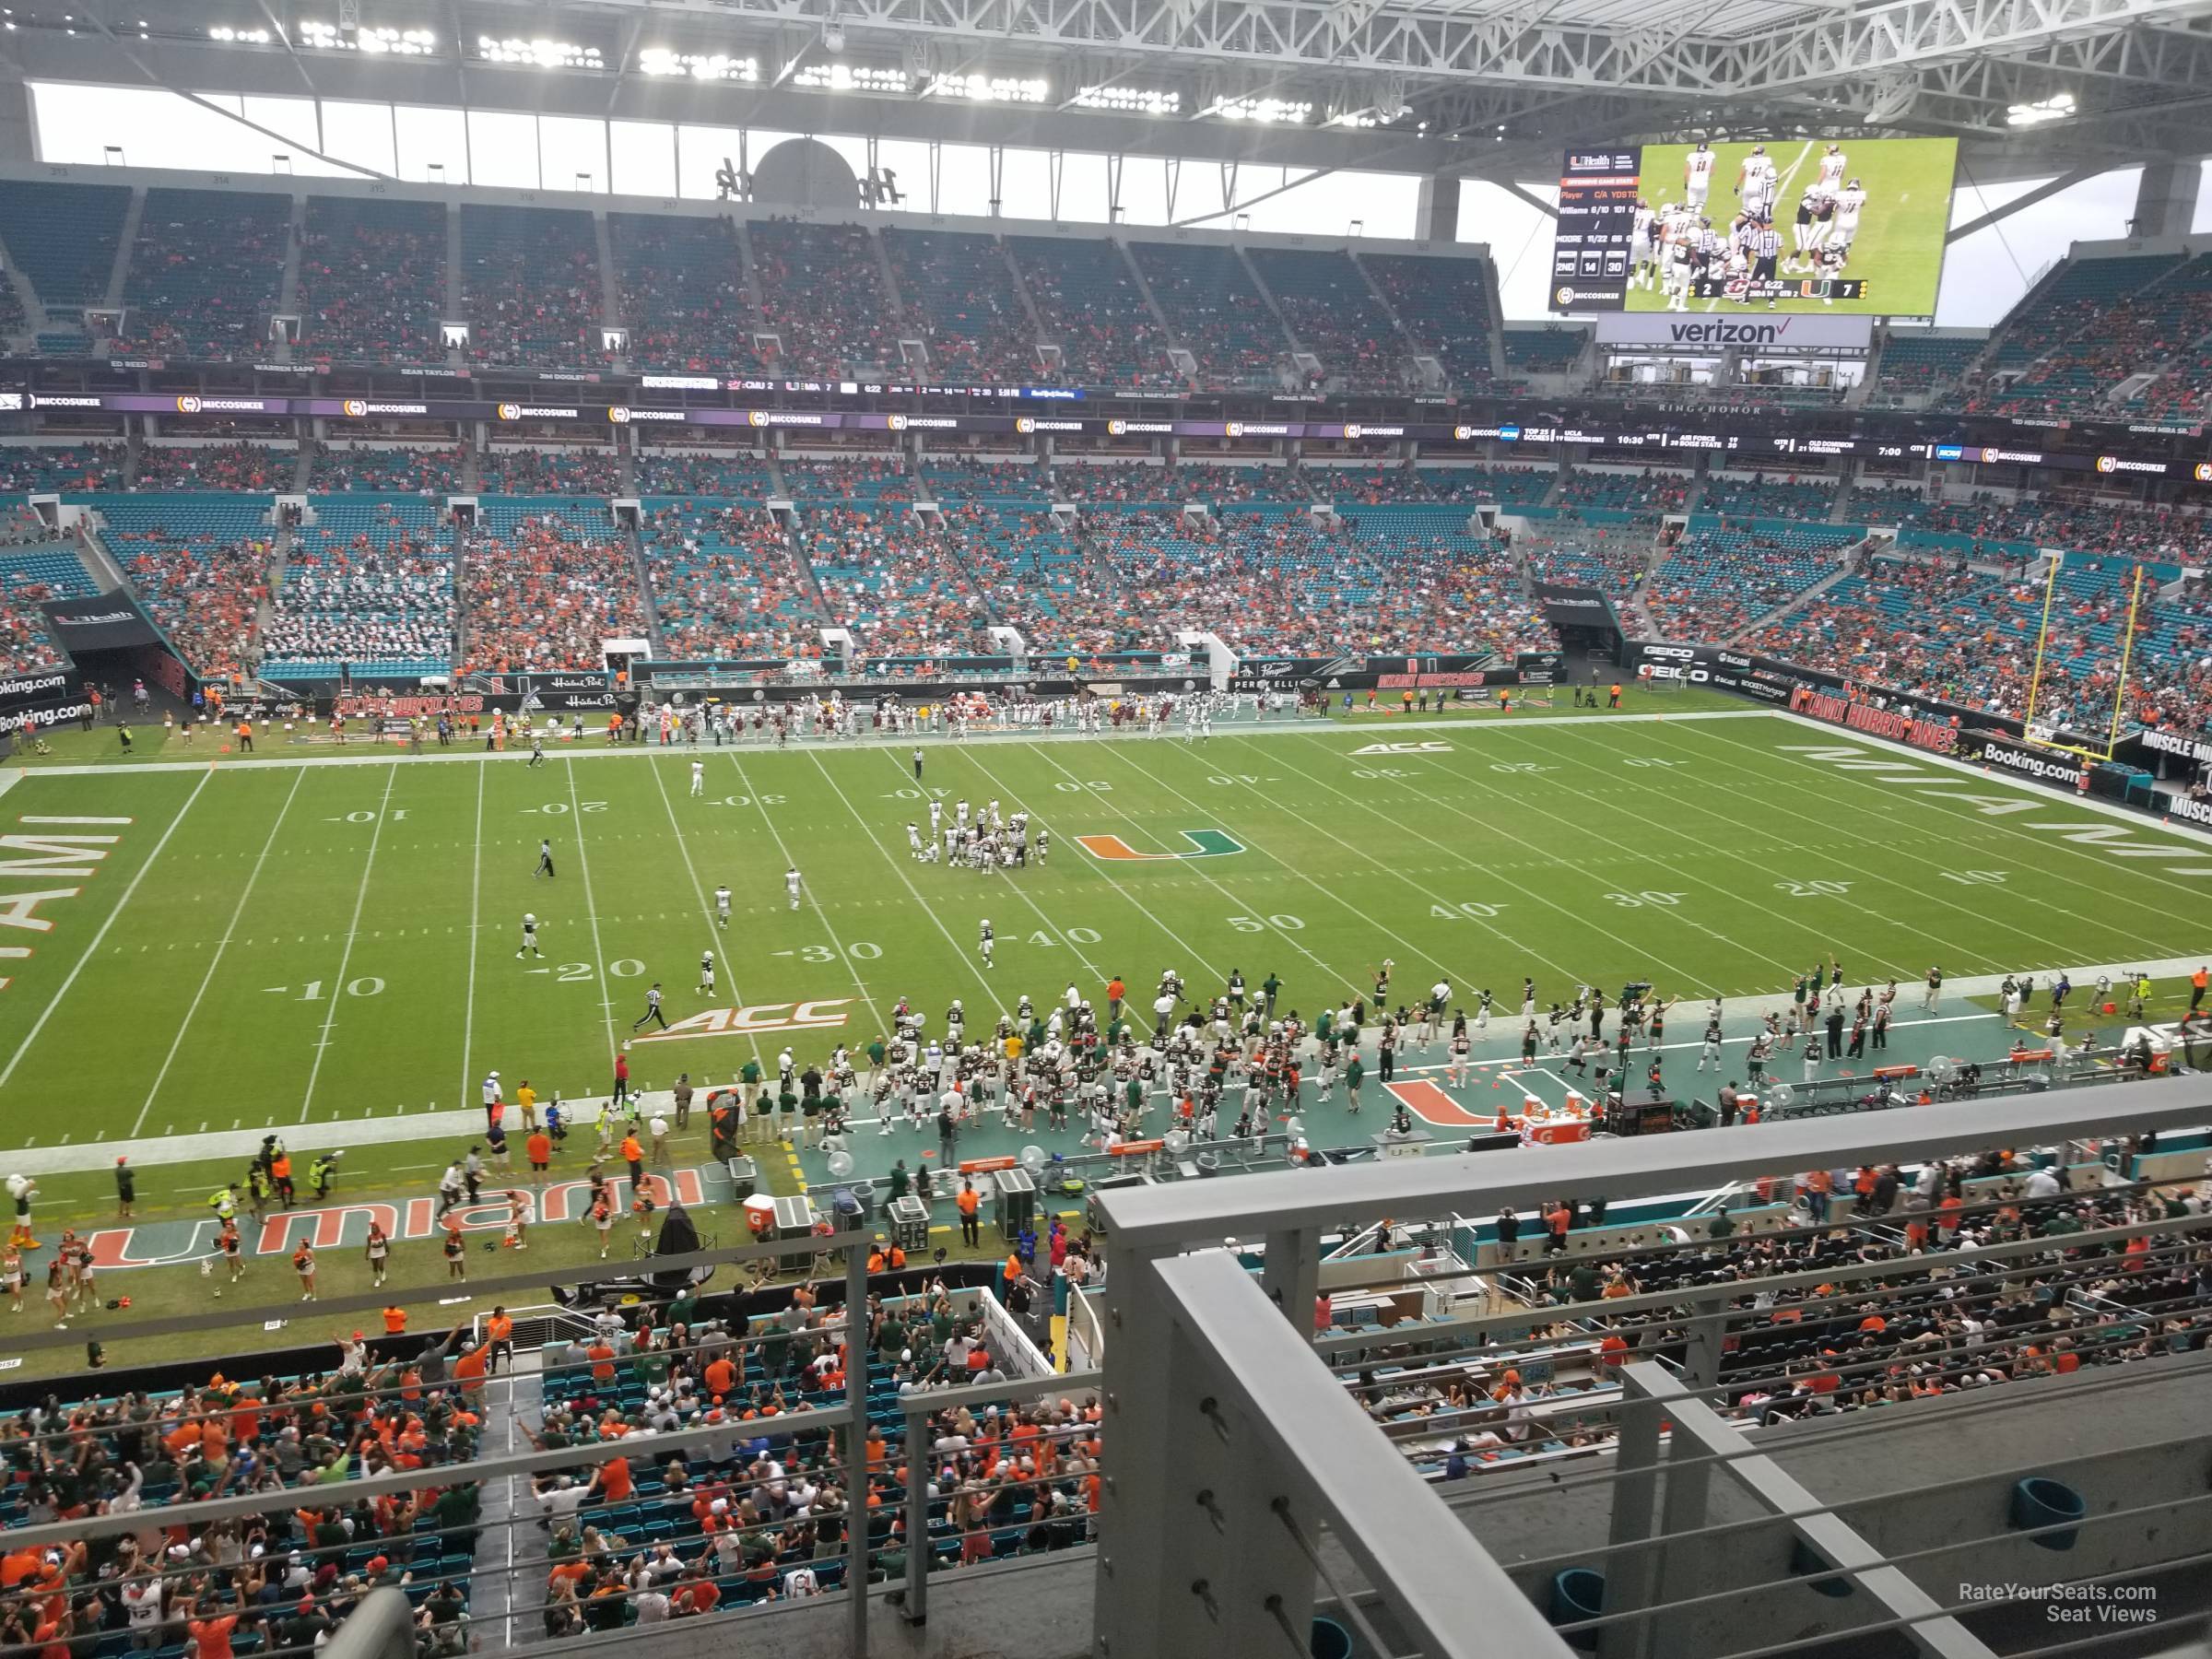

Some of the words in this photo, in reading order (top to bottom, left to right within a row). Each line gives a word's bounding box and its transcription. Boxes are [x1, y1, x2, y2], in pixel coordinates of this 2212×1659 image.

[213, 175, 229, 185] 314
[369, 183, 385, 194] 315
[1560, 191, 1584, 200] Player
[1594, 190, 1608, 199] C/A
[1611, 190, 1628, 199] YDS
[1628, 190, 1638, 199] TD
[1559, 206, 1589, 215] Williams
[1591, 206, 1609, 215] 6/10
[1613, 206, 1626, 214] 101
[1628, 206, 1635, 214] 0
[1556, 235, 1583, 243] MOORE
[1587, 235, 1608, 244] 11/22
[1556, 262, 1574, 272] 2ND
[1584, 262, 1596, 272] 14
[1607, 262, 1623, 272] 30
[1702, 283, 1712, 296] 2
[1764, 280, 1784, 290] 6:22
[1842, 284, 1853, 297] 7
[1671, 318, 1776, 344] verizon
[125, 360, 147, 369] REED
[425, 369, 456, 377] TAYLOR
[767, 382, 773, 391] 2
[36, 397, 100, 406] MICCOSUKEE
[202, 400, 265, 410] MICCOSUKEE
[368, 404, 427, 414] MICCOSUKEE
[521, 408, 578, 418] MICCOSUKEE
[1658, 404, 1694, 413] RING
[1708, 405, 1761, 415] HONOR
[631, 411, 685, 420] MICCOSUKEE
[770, 416, 822, 425] MICCOSUKEE
[907, 418, 957, 428] MICCOSUKEE
[1035, 421, 1083, 430] MICCOSUKEE
[1125, 424, 1172, 432] MICCOSUKEE
[1243, 426, 1288, 434] MICCOSUKEE
[1360, 428, 1404, 436] MICCOSUKEE
[1617, 435, 1643, 444] 10:30
[1700, 441, 1722, 449] STATE
[1808, 446, 1841, 454] VIRGINIA
[1878, 446, 1901, 456] 7:00
[1997, 452, 2042, 463] MICCOSUKEE
[2116, 462, 2167, 472] MICCOSUKEE
[1643, 645, 1694, 658] GEICO
[1235, 680, 1270, 689] PERY
[1347, 740, 1454, 755] ACC
[2141, 730, 2194, 757] MUSCLE
[1984, 743, 2081, 784] Booking.com
[1074, 828, 1248, 862] U
[1938, 869, 2006, 886] 10
[1772, 879, 1850, 897] 20
[1603, 889, 1679, 908] 30
[1430, 901, 1500, 920] 40
[1225, 913, 1306, 933] 50
[1027, 926, 1103, 947] 40
[801, 941, 885, 963] 30
[557, 959, 646, 982] 20
[294, 976, 385, 1002] 10
[1166, 983, 1175, 992] 15
[638, 997, 857, 1042] ACC
[919, 1080, 929, 1089] 53
[1539, 1129, 1553, 1144] G
[749, 1211, 761, 1225] G
